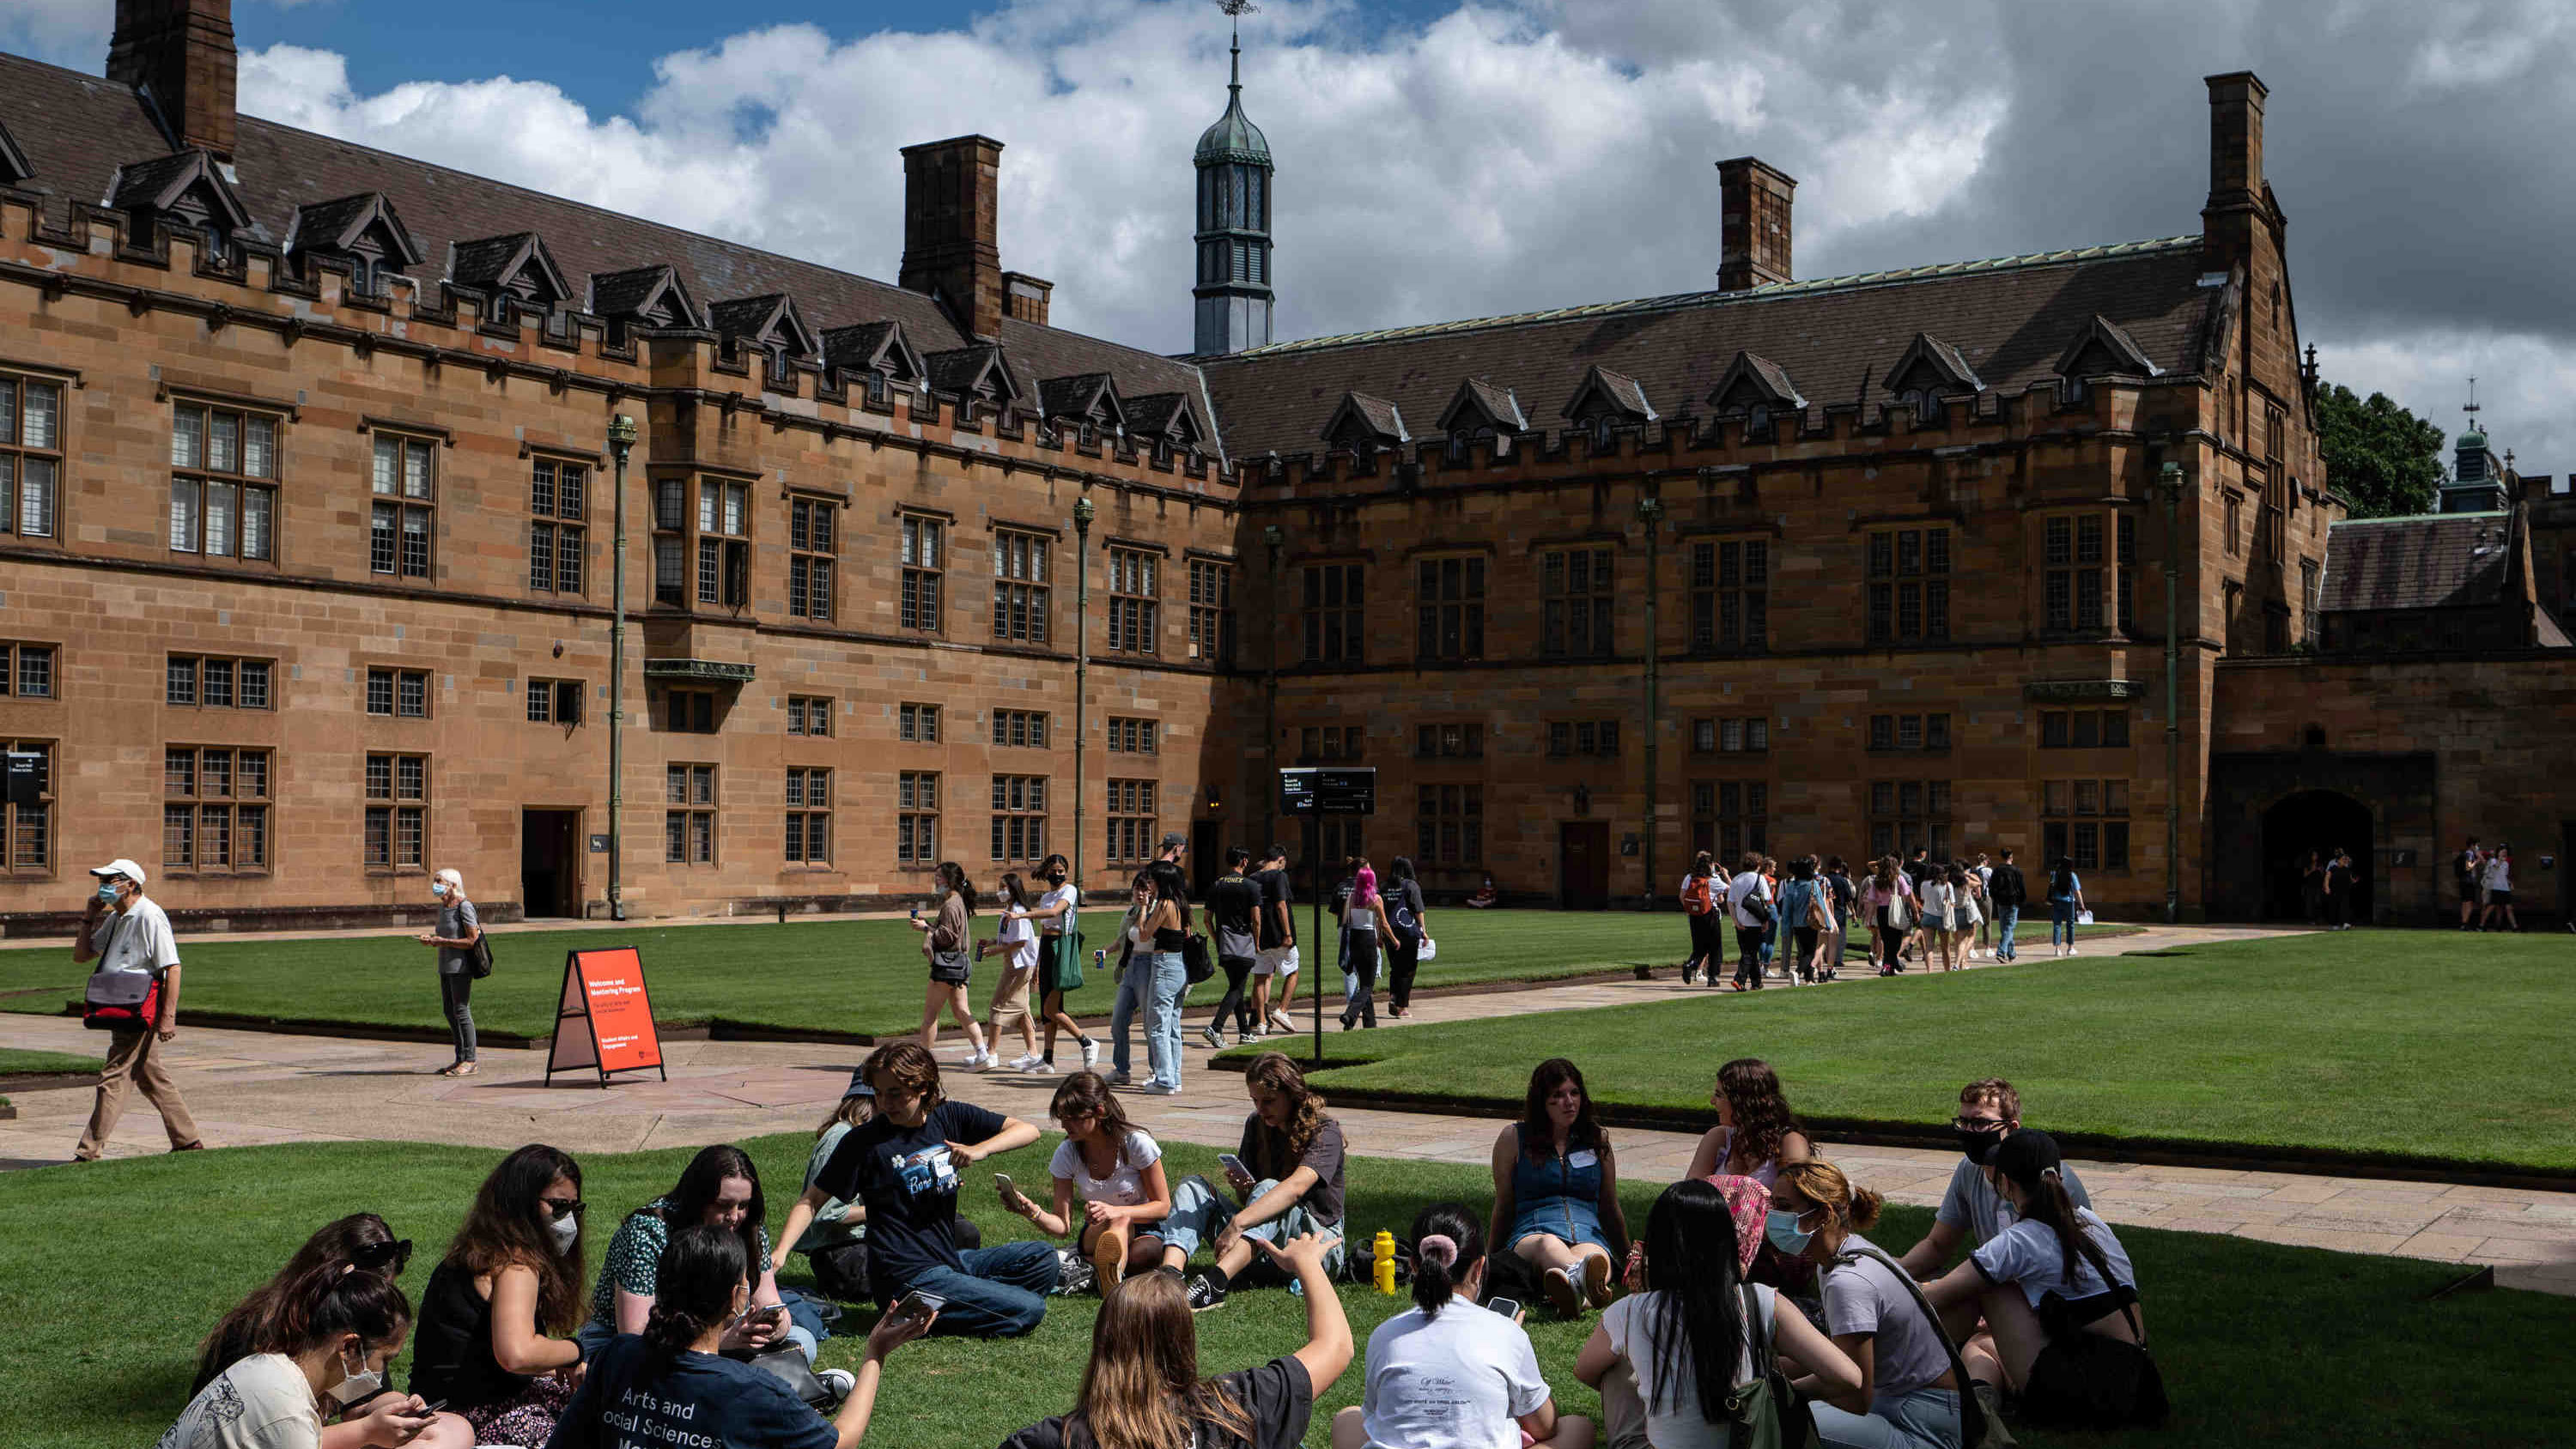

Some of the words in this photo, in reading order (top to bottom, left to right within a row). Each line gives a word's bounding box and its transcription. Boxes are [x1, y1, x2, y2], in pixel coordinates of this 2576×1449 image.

[591, 988, 618, 997] Mentoring
[622, 1387, 657, 1410] Arts
[661, 1401, 695, 1420] and
[604, 1410, 638, 1432] ocial
[642, 1418, 721, 1449] Sciences
